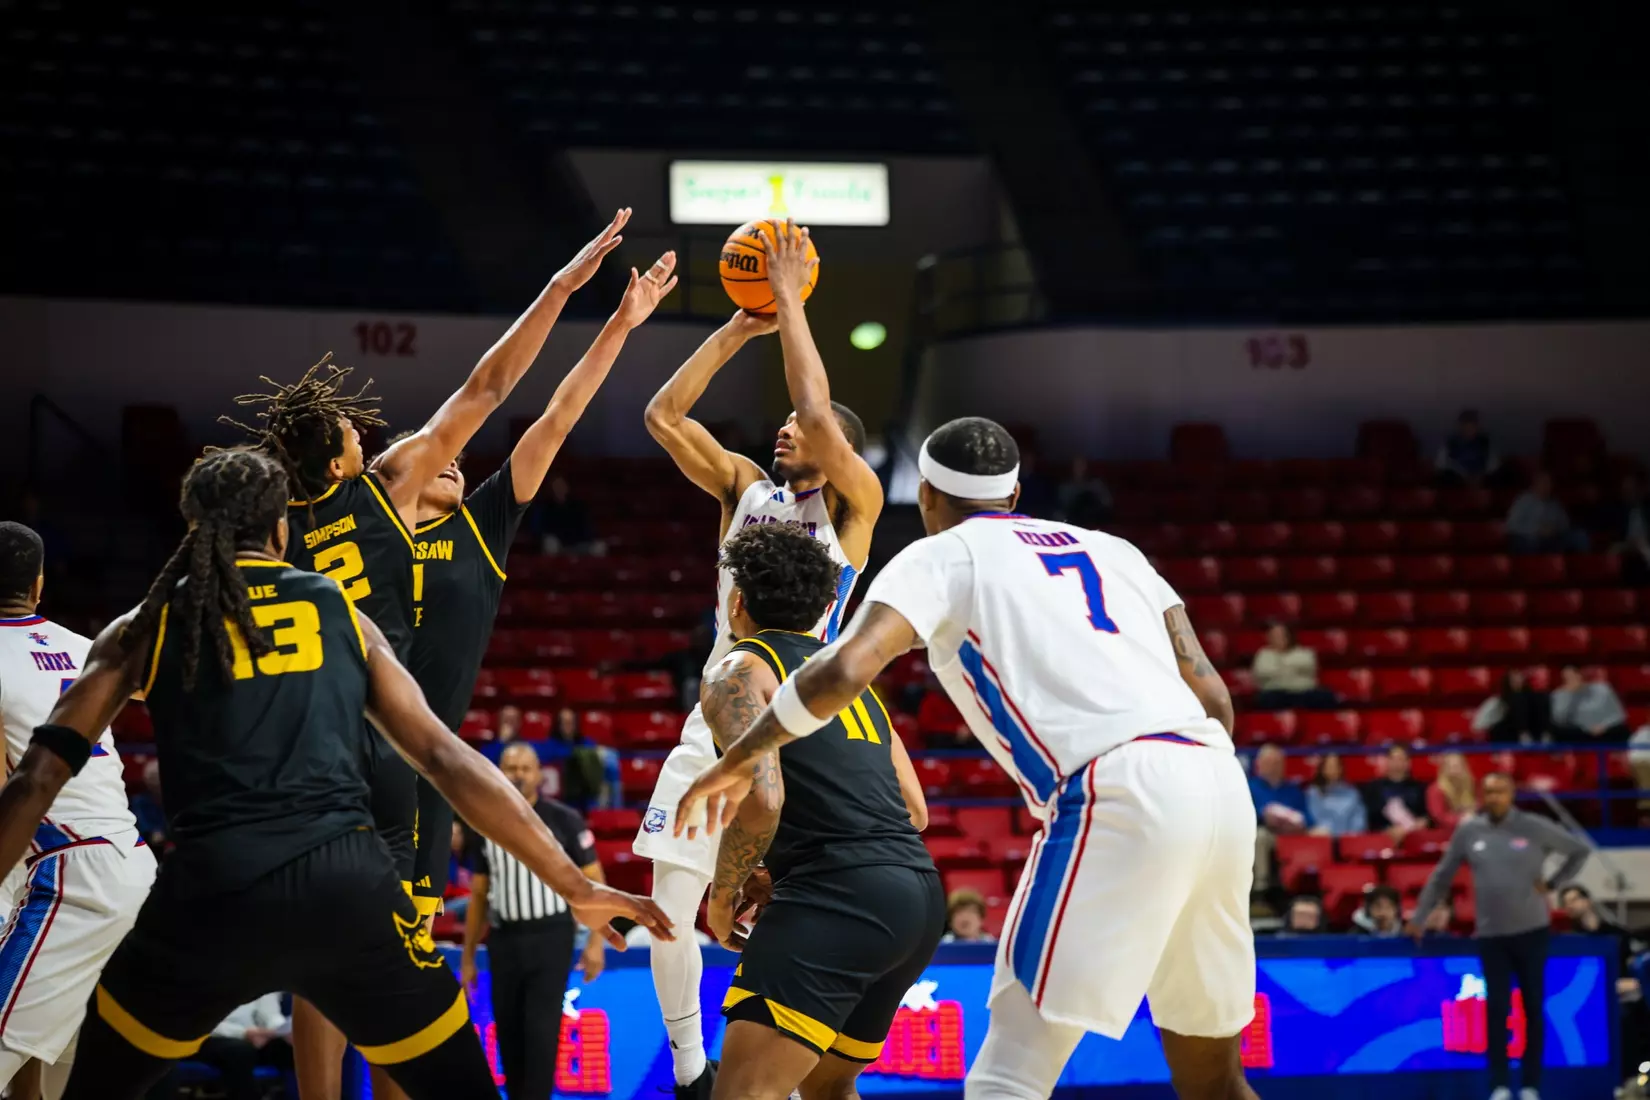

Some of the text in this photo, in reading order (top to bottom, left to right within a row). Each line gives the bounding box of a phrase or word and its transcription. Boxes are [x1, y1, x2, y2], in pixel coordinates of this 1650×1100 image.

[353, 321, 417, 356] 102
[303, 514, 358, 548] SIMPSON
[314, 541, 372, 601] 2
[1035, 551, 1120, 634] 7
[223, 600, 324, 681] 13
